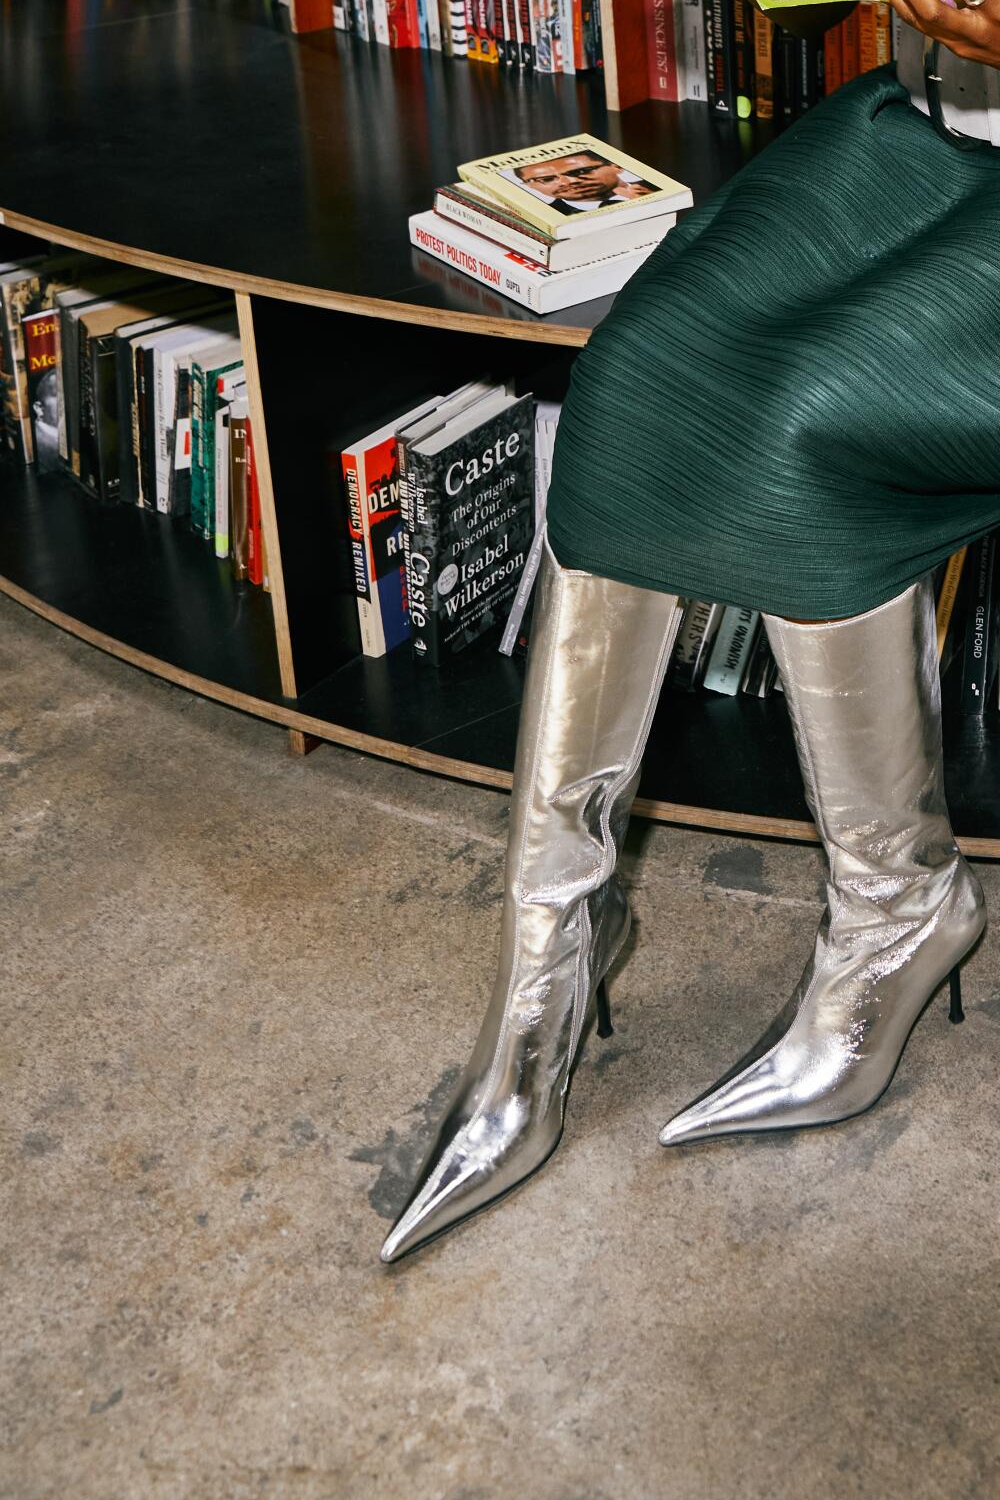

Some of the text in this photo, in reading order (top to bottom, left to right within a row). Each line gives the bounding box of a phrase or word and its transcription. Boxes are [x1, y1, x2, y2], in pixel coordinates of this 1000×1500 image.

[654, 9, 666, 45] SINCE
[656, 46, 668, 73] 1787
[416, 227, 502, 287] PROTEST POLITICS TODAY
[505, 278, 521, 294] GUPTA
[445, 432, 520, 496] Caste
[407, 472, 416, 533] Wilkerson
[417, 487, 428, 525] Isabel
[451, 474, 516, 523] The Origins
[467, 500, 502, 530] of Our
[346, 468, 367, 593] DEMOCRACY REMIXED
[452, 505, 518, 556] Discontents
[460, 534, 510, 582] Isabel
[411, 552, 430, 628] Caste
[444, 552, 524, 617] Wilkerson
[724, 626, 748, 670] UNIONISM
[973, 606, 984, 658] GLEN FORD
